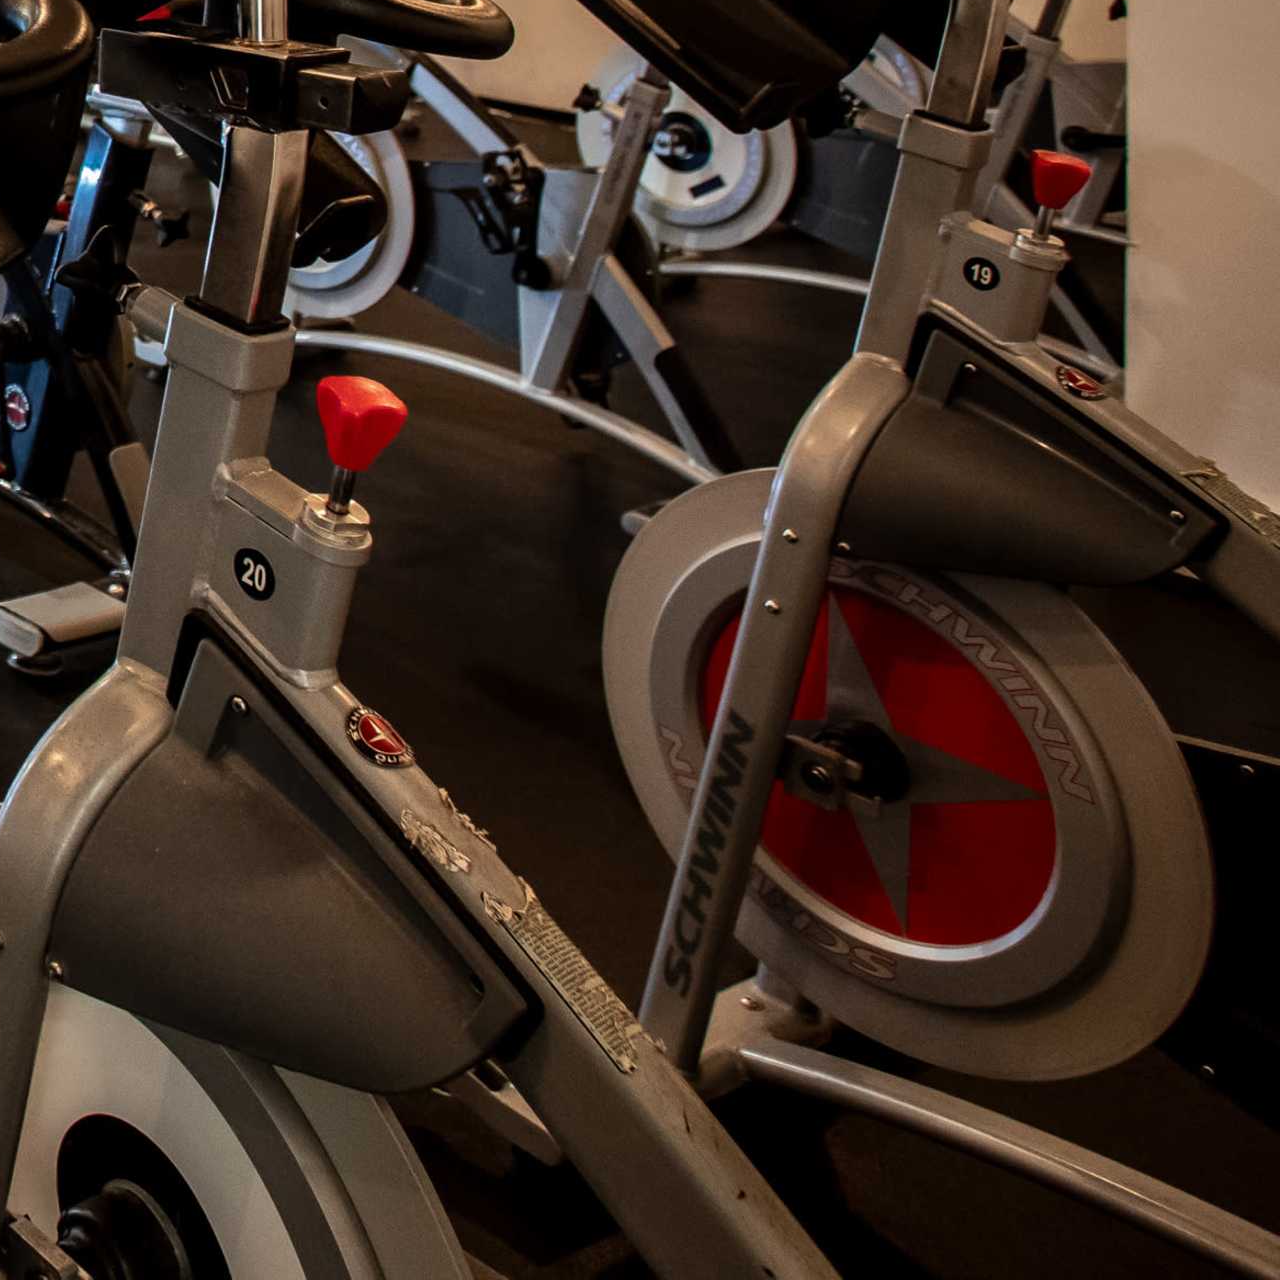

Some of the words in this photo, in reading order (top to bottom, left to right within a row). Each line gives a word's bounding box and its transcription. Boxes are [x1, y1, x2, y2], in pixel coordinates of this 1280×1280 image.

[970, 263, 994, 286] 19
[241, 556, 268, 593] 20
[662, 710, 754, 998] SCHWINN
